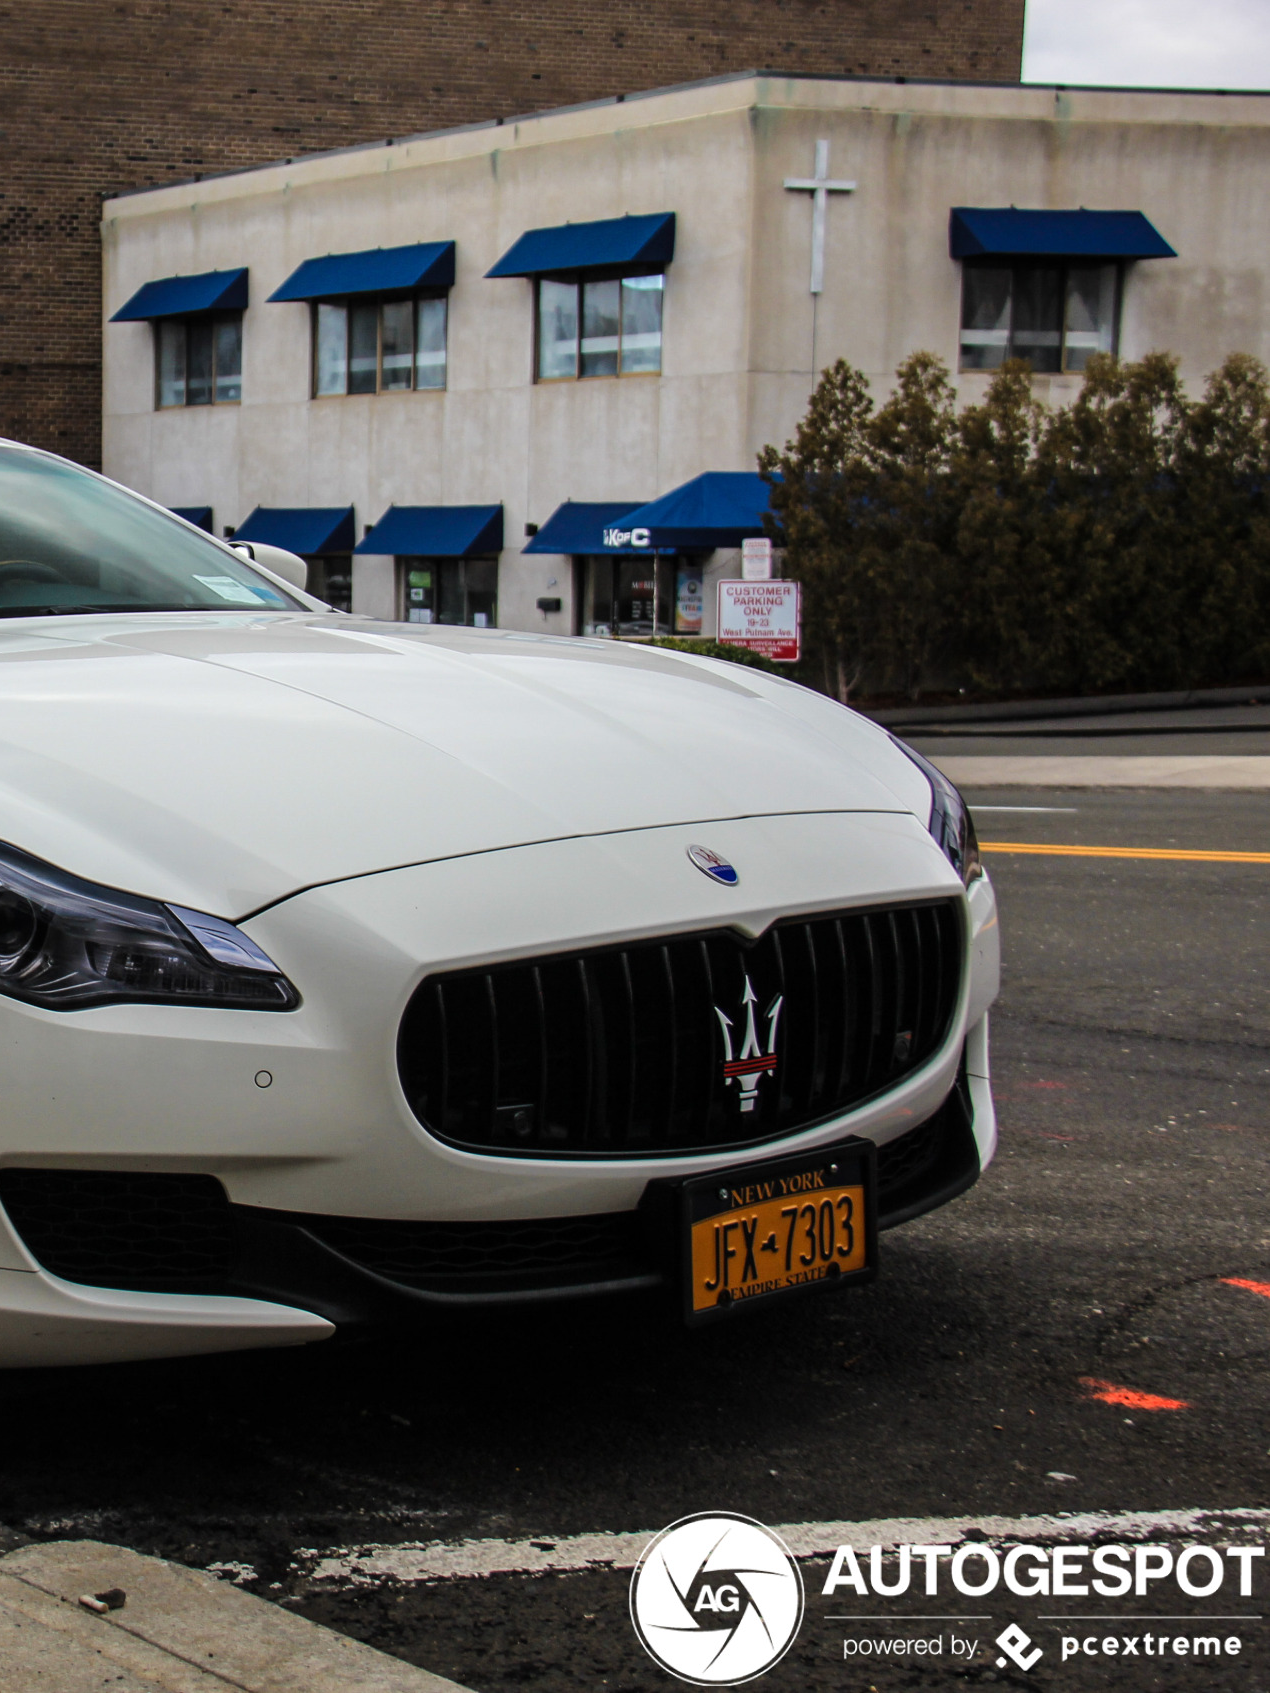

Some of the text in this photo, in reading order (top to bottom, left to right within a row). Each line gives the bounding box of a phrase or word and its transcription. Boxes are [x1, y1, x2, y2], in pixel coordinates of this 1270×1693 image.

[726, 586, 791, 596] CUSTOMER
[733, 597, 783, 606] PARKING
[743, 606, 772, 616] ONLY
[747, 618, 769, 627] 19-23
[723, 628, 793, 636] West Putnam Ave.
[731, 1170, 825, 1208] NEW YORK
[730, 1265, 826, 1300] EMPIRE STATE
